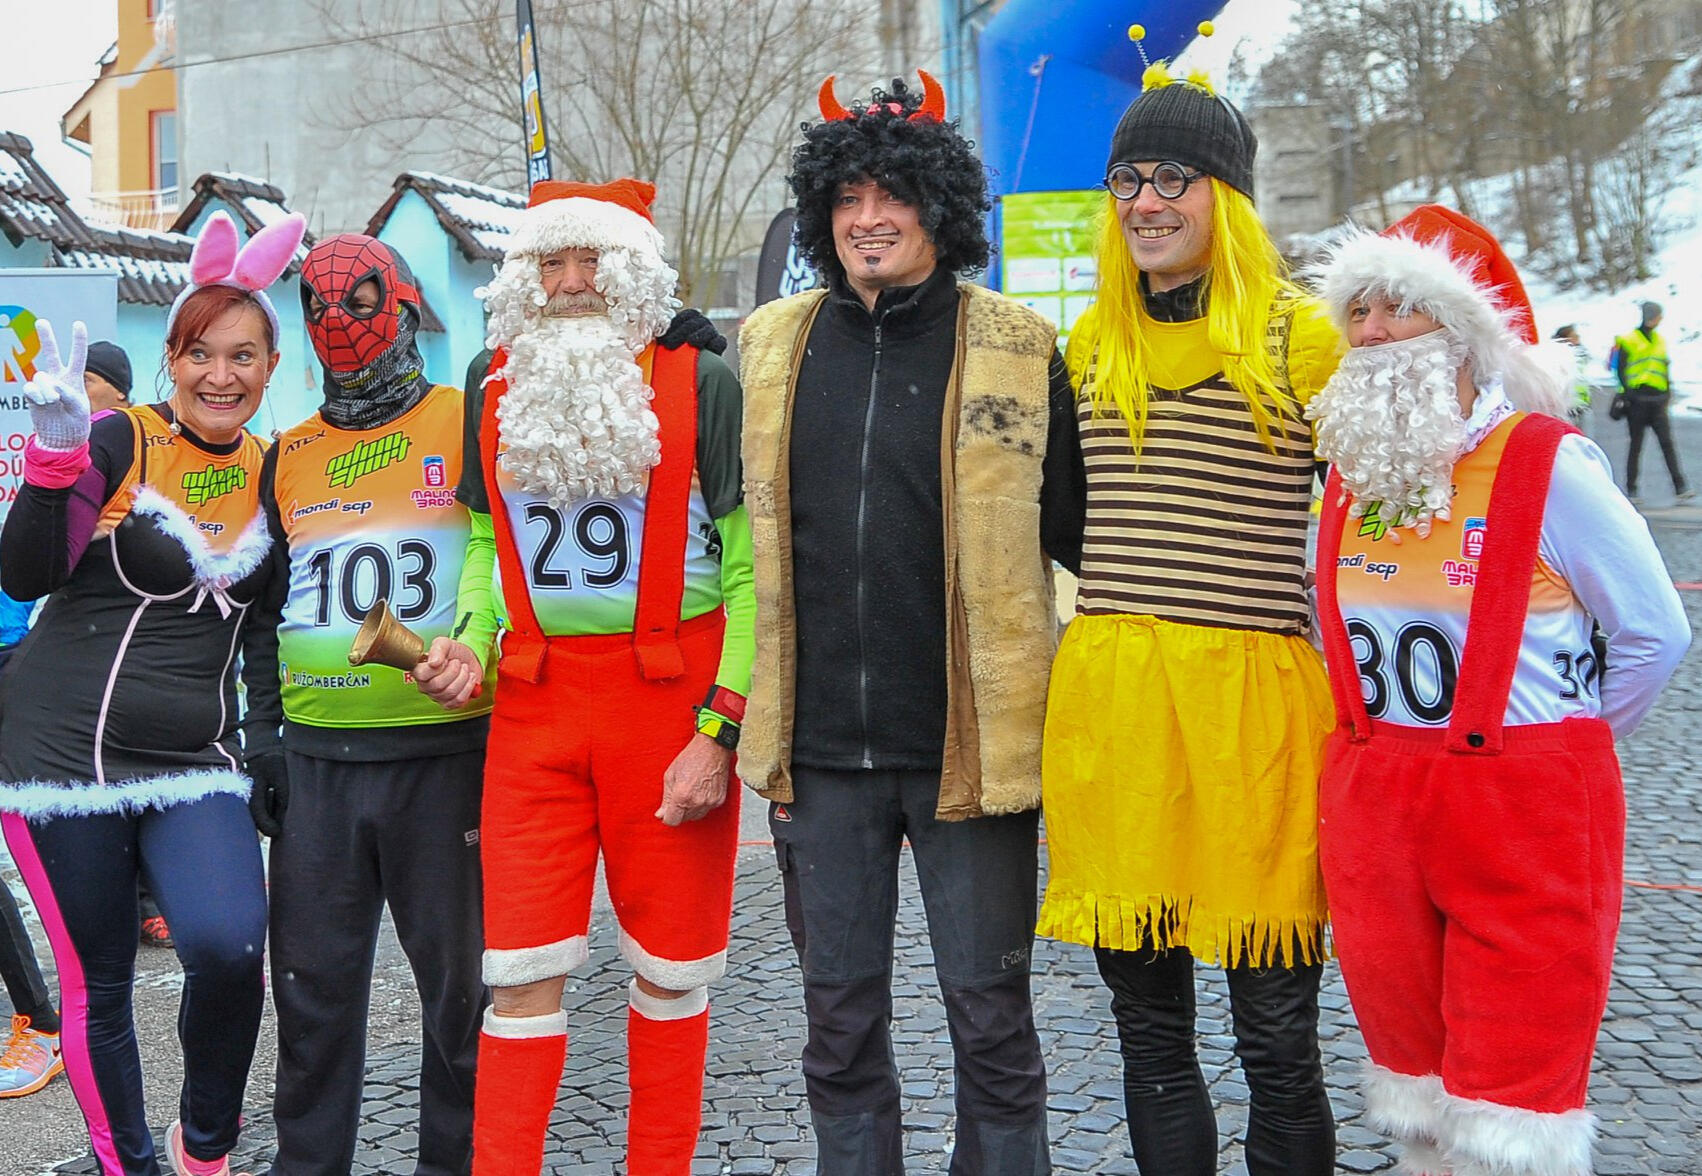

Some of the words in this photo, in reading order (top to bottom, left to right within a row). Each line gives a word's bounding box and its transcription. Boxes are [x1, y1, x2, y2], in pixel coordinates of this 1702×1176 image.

[146, 435, 176, 446] TEX
[284, 429, 326, 455] ATEX
[295, 499, 339, 518] mondi
[342, 501, 372, 514] scp
[199, 522, 224, 535] scp
[523, 501, 632, 590] 29
[1366, 562, 1397, 580] scp
[307, 538, 437, 627] 103
[292, 673, 370, 688] RUŽOMBERČAN
[1346, 617, 1460, 725] 30
